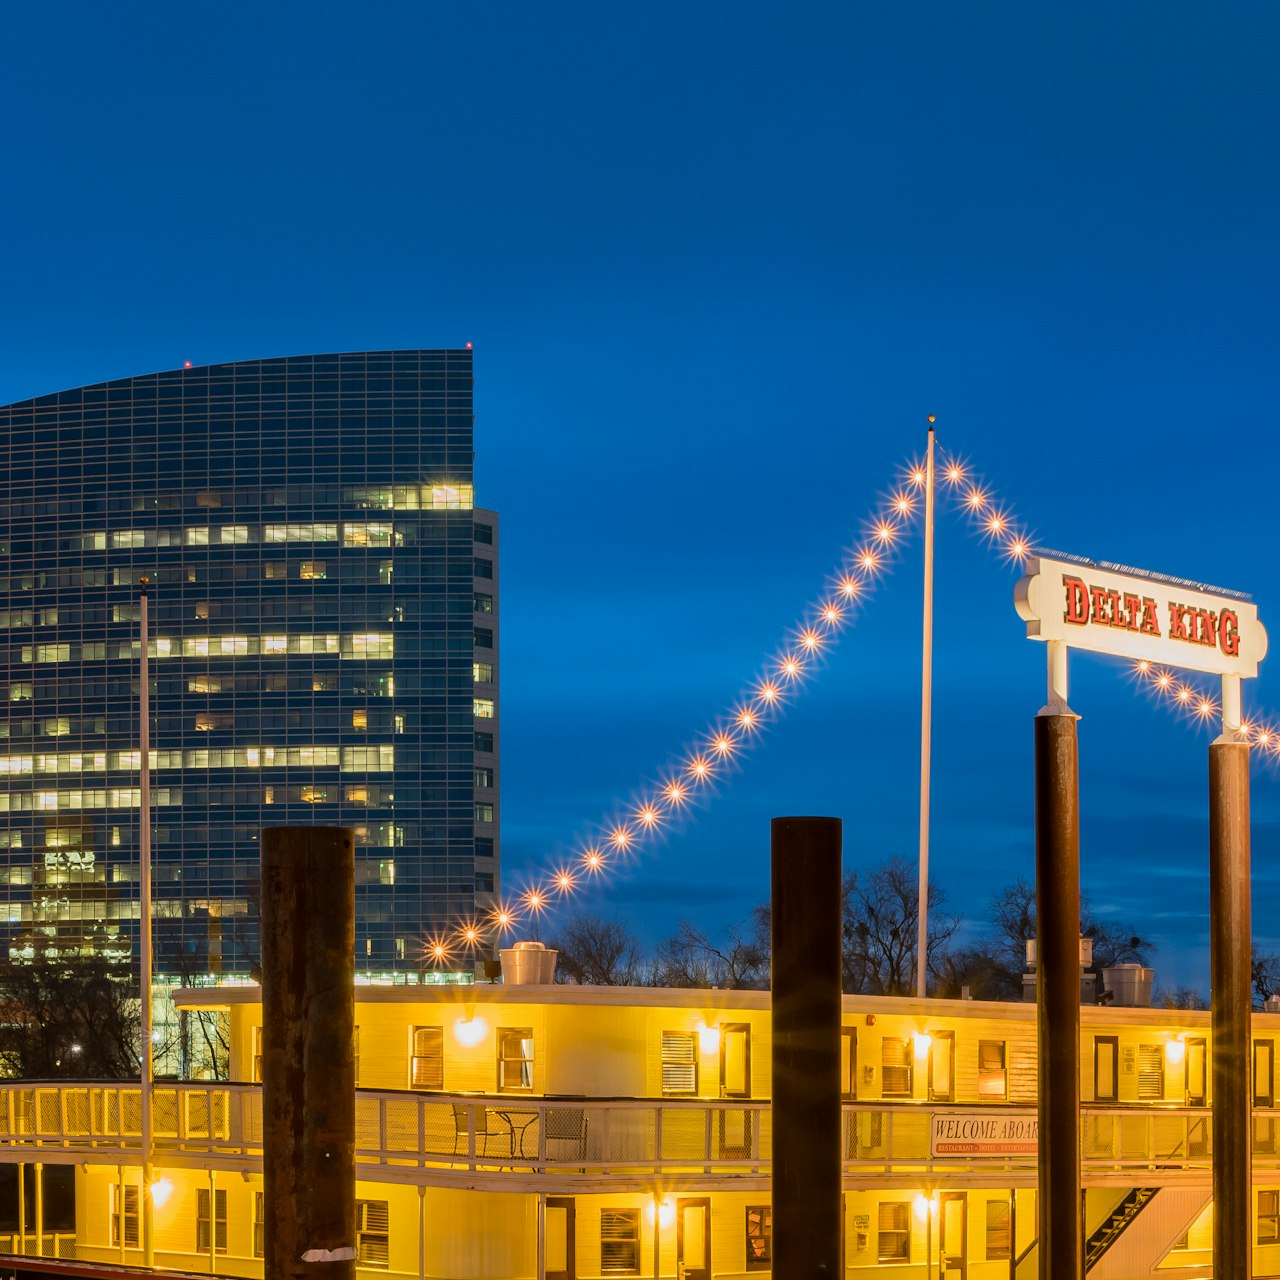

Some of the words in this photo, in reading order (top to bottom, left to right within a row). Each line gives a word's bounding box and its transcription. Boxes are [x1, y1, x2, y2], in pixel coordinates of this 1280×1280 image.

[1062, 574, 1161, 637] DELTA
[1168, 601, 1240, 657] KING
[936, 1120, 997, 1139] WELCOME
[999, 1120, 1038, 1139] ABOAR
[938, 1144, 974, 1152] RESTAURANT
